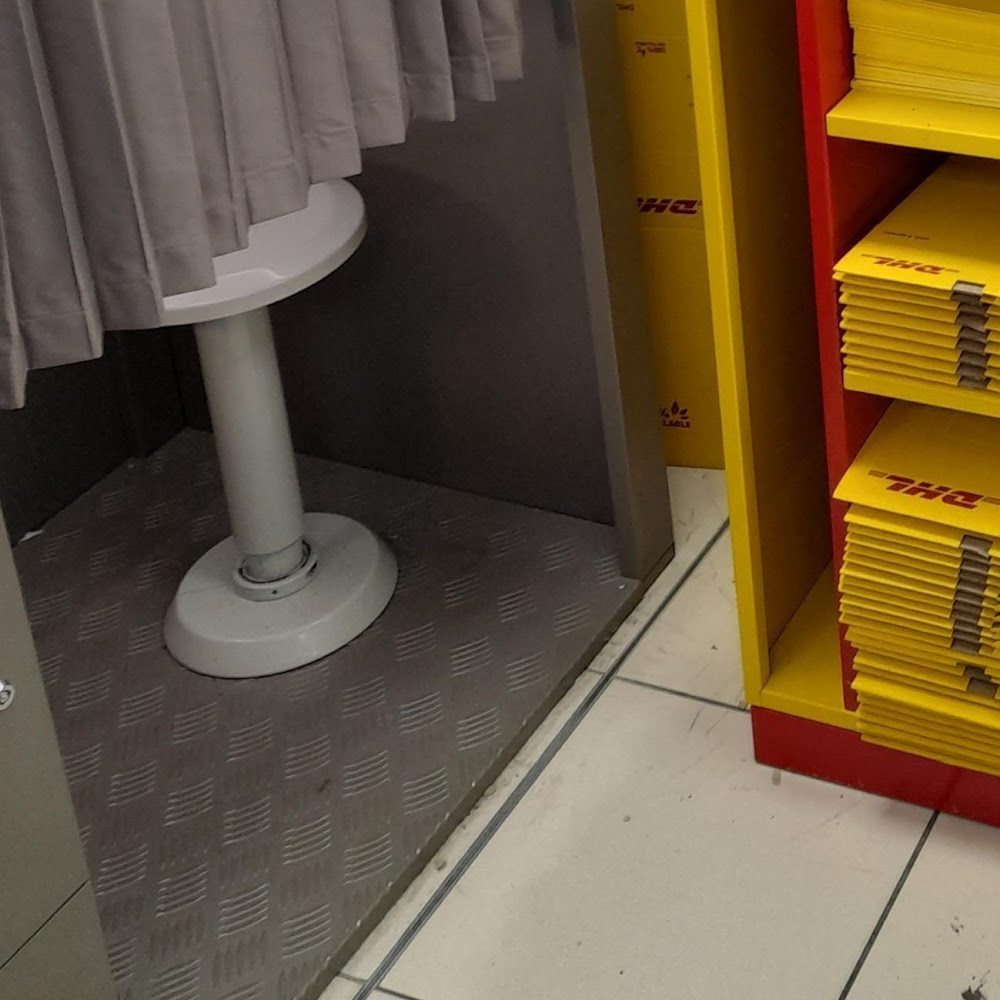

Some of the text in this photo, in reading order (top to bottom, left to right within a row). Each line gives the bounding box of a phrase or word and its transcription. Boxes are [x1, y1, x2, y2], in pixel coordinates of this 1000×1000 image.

[636, 198, 699, 215] DH
[873, 257, 942, 275] DHL
[884, 474, 984, 509] DHL
